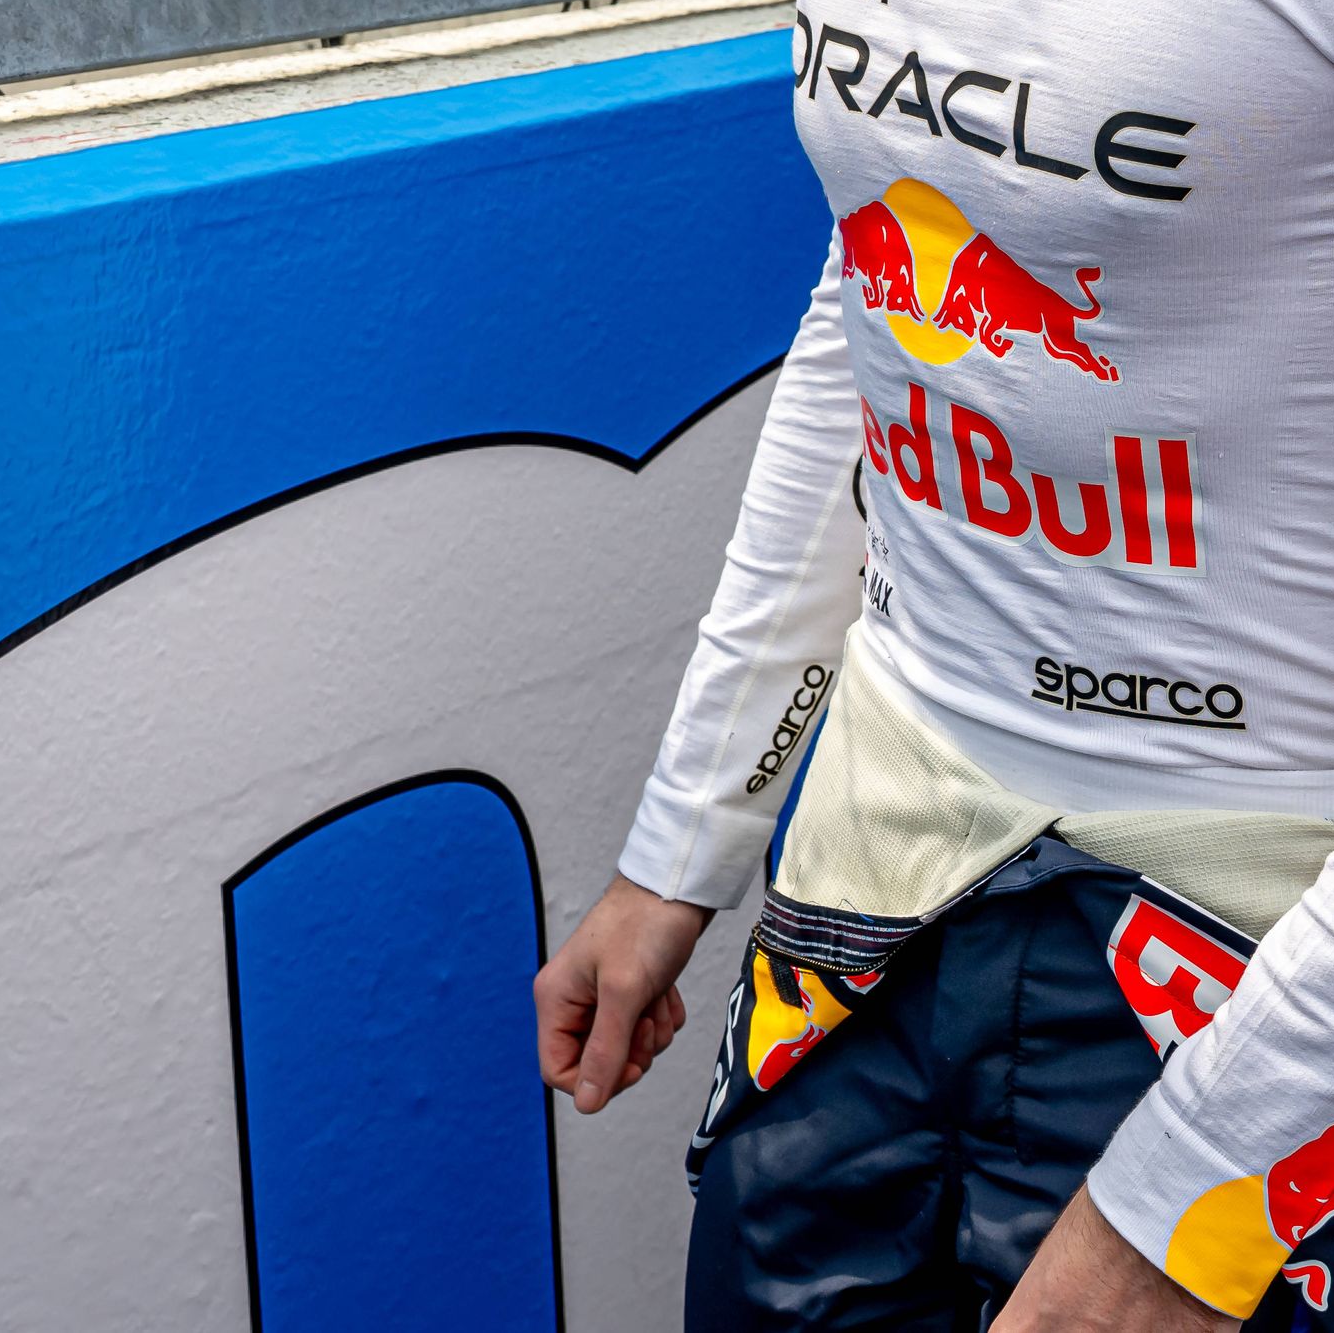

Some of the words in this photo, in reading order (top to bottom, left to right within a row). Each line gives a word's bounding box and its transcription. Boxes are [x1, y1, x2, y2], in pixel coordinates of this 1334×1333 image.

[860, 381, 944, 512] ed
[951, 402, 1198, 570] Bull
[746, 664, 831, 797] sparco
[1032, 655, 1246, 724] sparco
